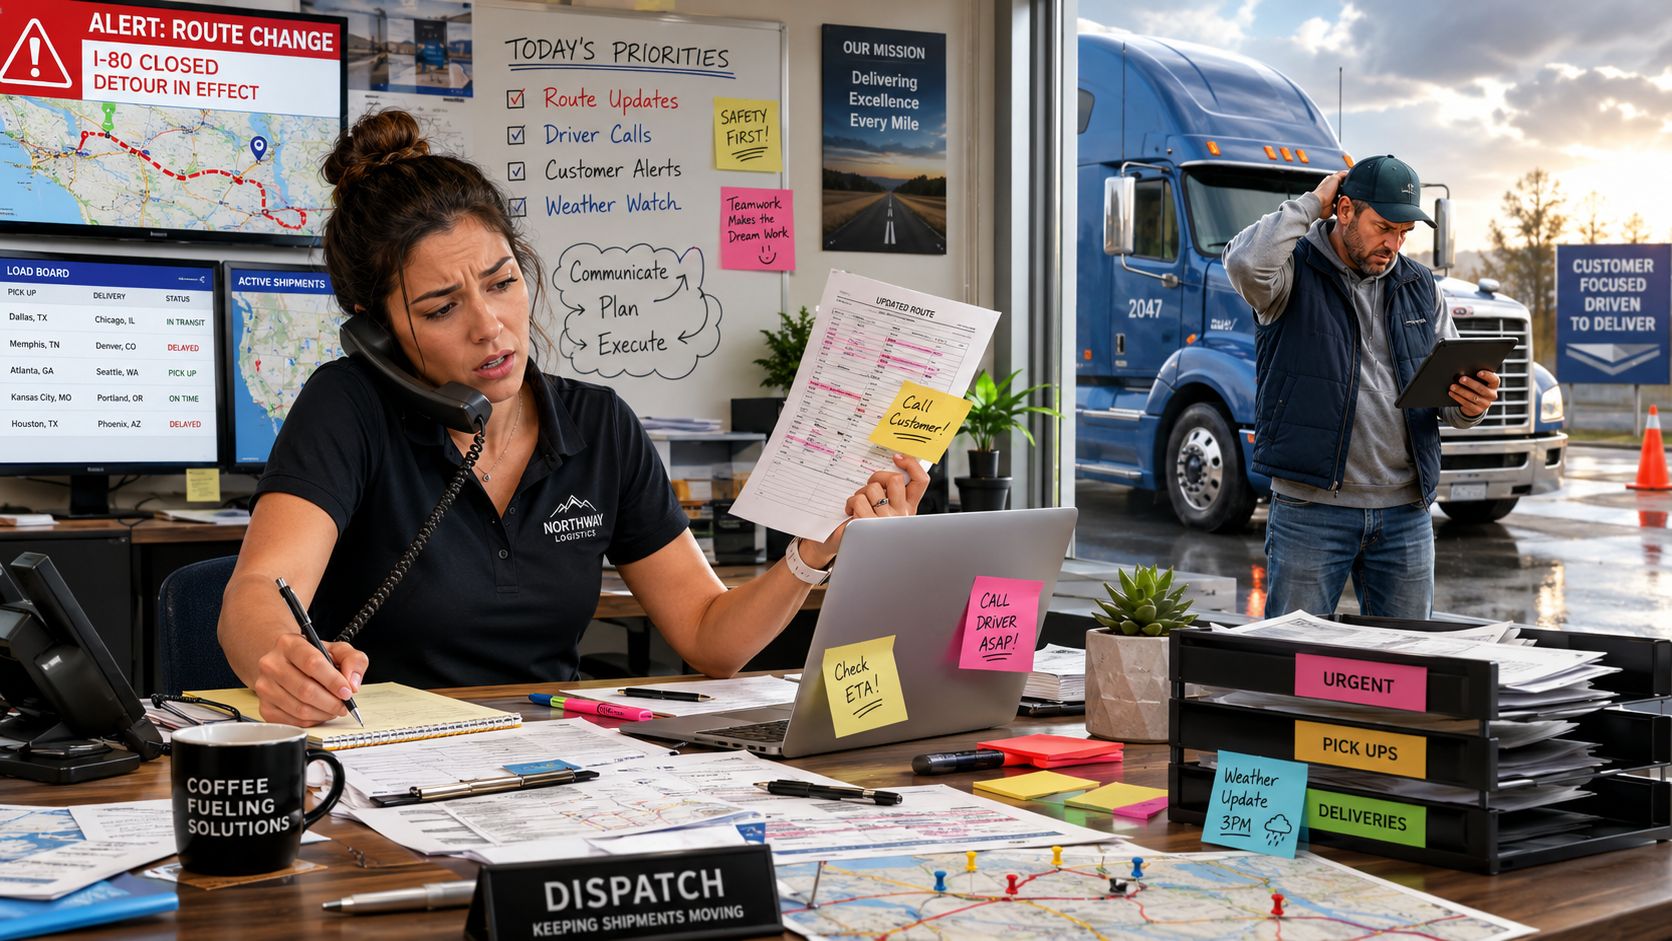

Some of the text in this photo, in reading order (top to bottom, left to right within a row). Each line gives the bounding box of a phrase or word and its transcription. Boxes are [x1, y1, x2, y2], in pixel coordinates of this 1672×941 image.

[89, 12, 333, 52] ALERT: ROUTE CHANGE
[505, 37, 729, 67] TODAY'S PRIORITIES
[843, 41, 925, 59] OUR MISSION
[94, 50, 218, 75] I-80 CLOSED
[94, 74, 259, 100] DETOUR IN EFFECT
[852, 71, 917, 91] Delivering
[543, 87, 679, 116] Route Updates
[849, 92, 919, 109] Excellence
[721, 108, 768, 124] SAFETY
[850, 113, 919, 132] Every Mile
[544, 124, 651, 144] Driver Calls
[727, 126, 769, 146] FIRST!
[545, 159, 681, 180] Customer Alerts
[546, 192, 681, 216] Weather Watch
[727, 196, 782, 211] Teamwork
[728, 214, 774, 227] Makes the
[728, 226, 789, 243] Dream Work
[7, 266, 69, 278] LOAD BOARD
[570, 260, 669, 282] Communicate
[1573, 259, 1654, 273] CUSTOMER
[238, 277, 325, 288] ACTIVE SHIPMENTS
[1580, 277, 1647, 292] FOCUSED
[8, 288, 23, 296] PICK
[93, 292, 125, 300] DELIVERY
[599, 295, 638, 319] Plan
[876, 297, 909, 313] UPDATED
[910, 304, 935, 318] ROUTE
[1128, 299, 1162, 318] 2047
[1585, 297, 1640, 312] DRIVEN
[9, 313, 47, 323] Dallas, TX
[95, 315, 126, 325] Chicago,
[175, 319, 205, 327] TRANSIT
[1570, 316, 1655, 331] TO DELIVER
[10, 340, 46, 350] Memphis,
[96, 342, 123, 351] Denver,
[168, 344, 199, 352] DELAYED
[599, 330, 667, 355] Execute
[10, 367, 40, 376] Atlanta,
[96, 368, 124, 377] Seattle,
[168, 369, 184, 377] PICK
[40, 394, 56, 403] City,
[97, 394, 143, 403] Portland, OR
[902, 395, 931, 413] Call
[12, 420, 58, 430] Houston, TX
[98, 420, 129, 430] Phoenix,
[890, 413, 950, 436] Customer!
[544, 513, 603, 534] NORTHWAY
[555, 530, 596, 542] LOGISTICS
[980, 592, 1009, 609] CALL
[979, 633, 1018, 651] ASAP!
[835, 656, 869, 681] Check
[846, 674, 879, 703] ETA!
[1323, 671, 1394, 694] URGENT
[1322, 737, 1398, 761] PICK UPS
[1224, 767, 1279, 787] Weather
[187, 777, 268, 796] COFFEE
[188, 798, 275, 817] FUELING
[1221, 790, 1268, 809] Update
[188, 816, 290, 836] SOLUTIONS
[1220, 815, 1251, 832] 3PM
[1319, 803, 1407, 832] DELIVERIES
[544, 868, 725, 912] DISPATCH
[533, 905, 744, 937] KEEPING SHIPMENTS MOVING
